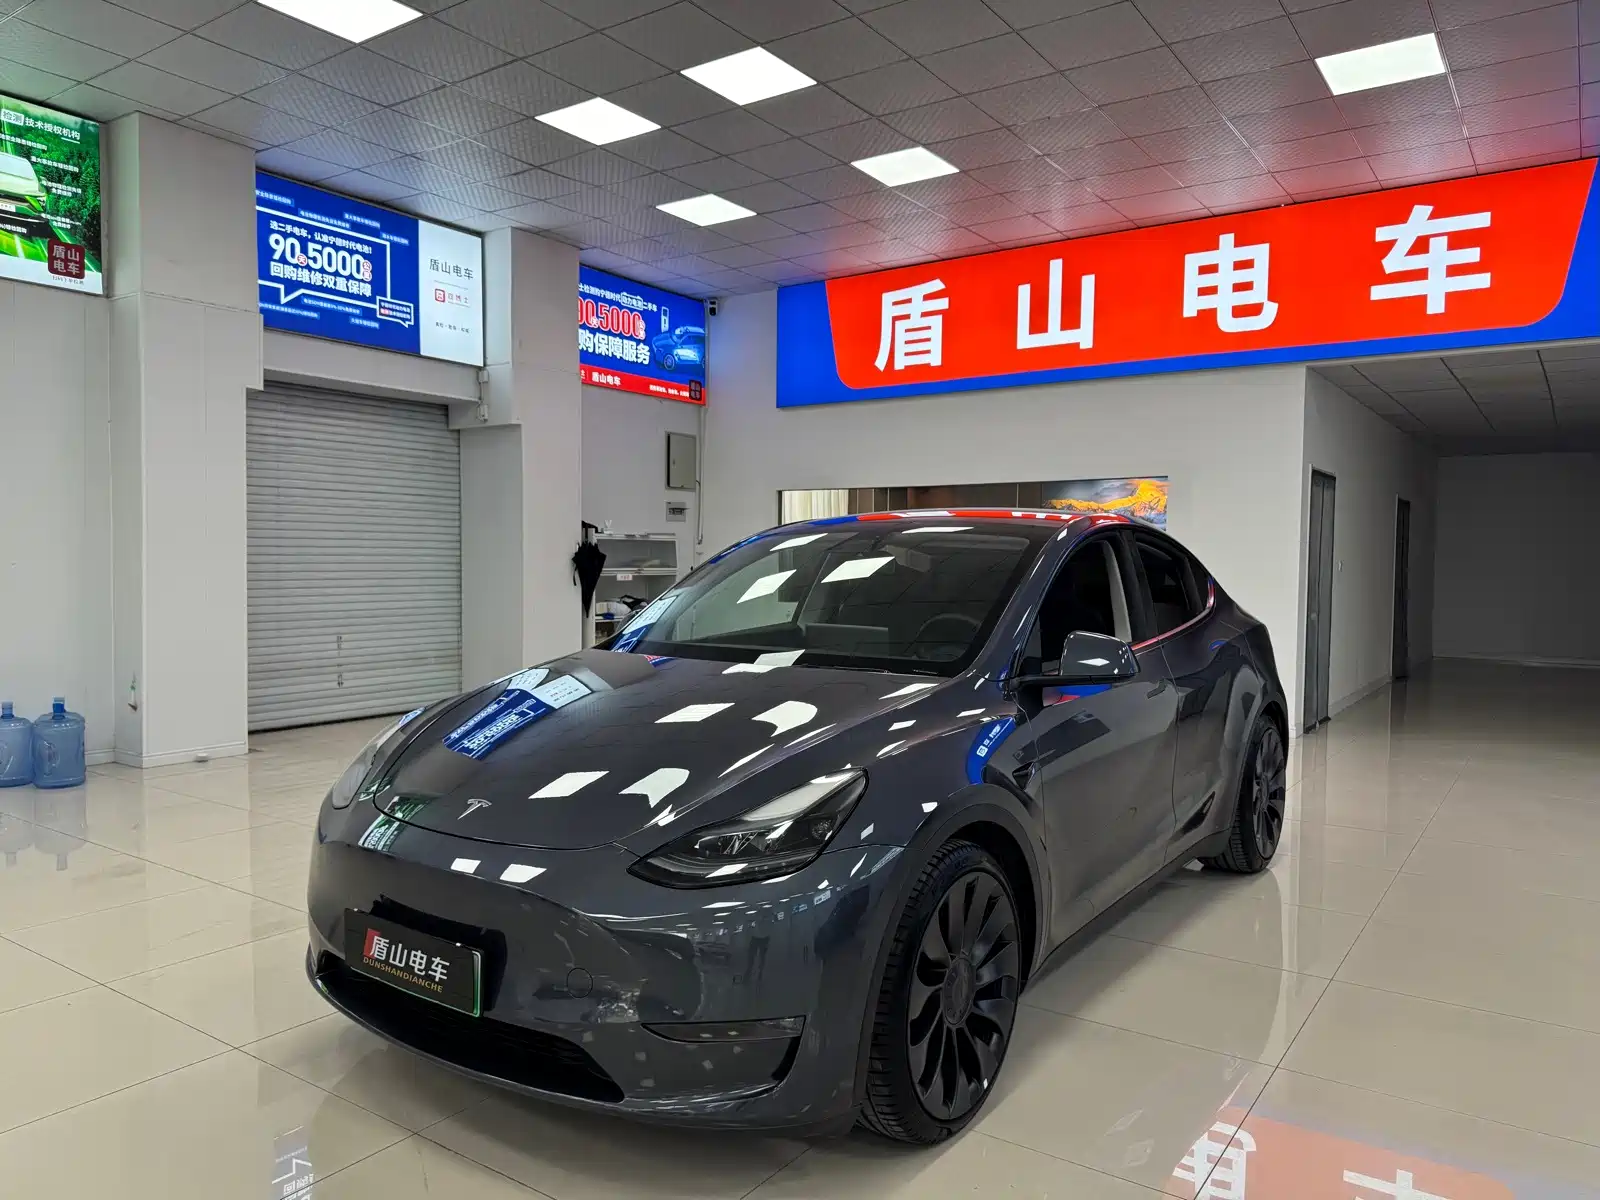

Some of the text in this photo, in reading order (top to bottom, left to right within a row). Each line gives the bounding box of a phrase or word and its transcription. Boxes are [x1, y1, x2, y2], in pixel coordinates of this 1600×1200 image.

[52, 244, 80, 262] 盾山
[53, 258, 81, 275] 电车
[270, 261, 372, 297] 回购维修双重保障
[429, 258, 474, 280] 盾山电车
[874, 204, 1492, 372] 盾山电车
[592, 371, 621, 387] 盾山电车
[369, 935, 450, 982] 盾山电车
[363, 956, 444, 993] DUNSHANDIANCHE
